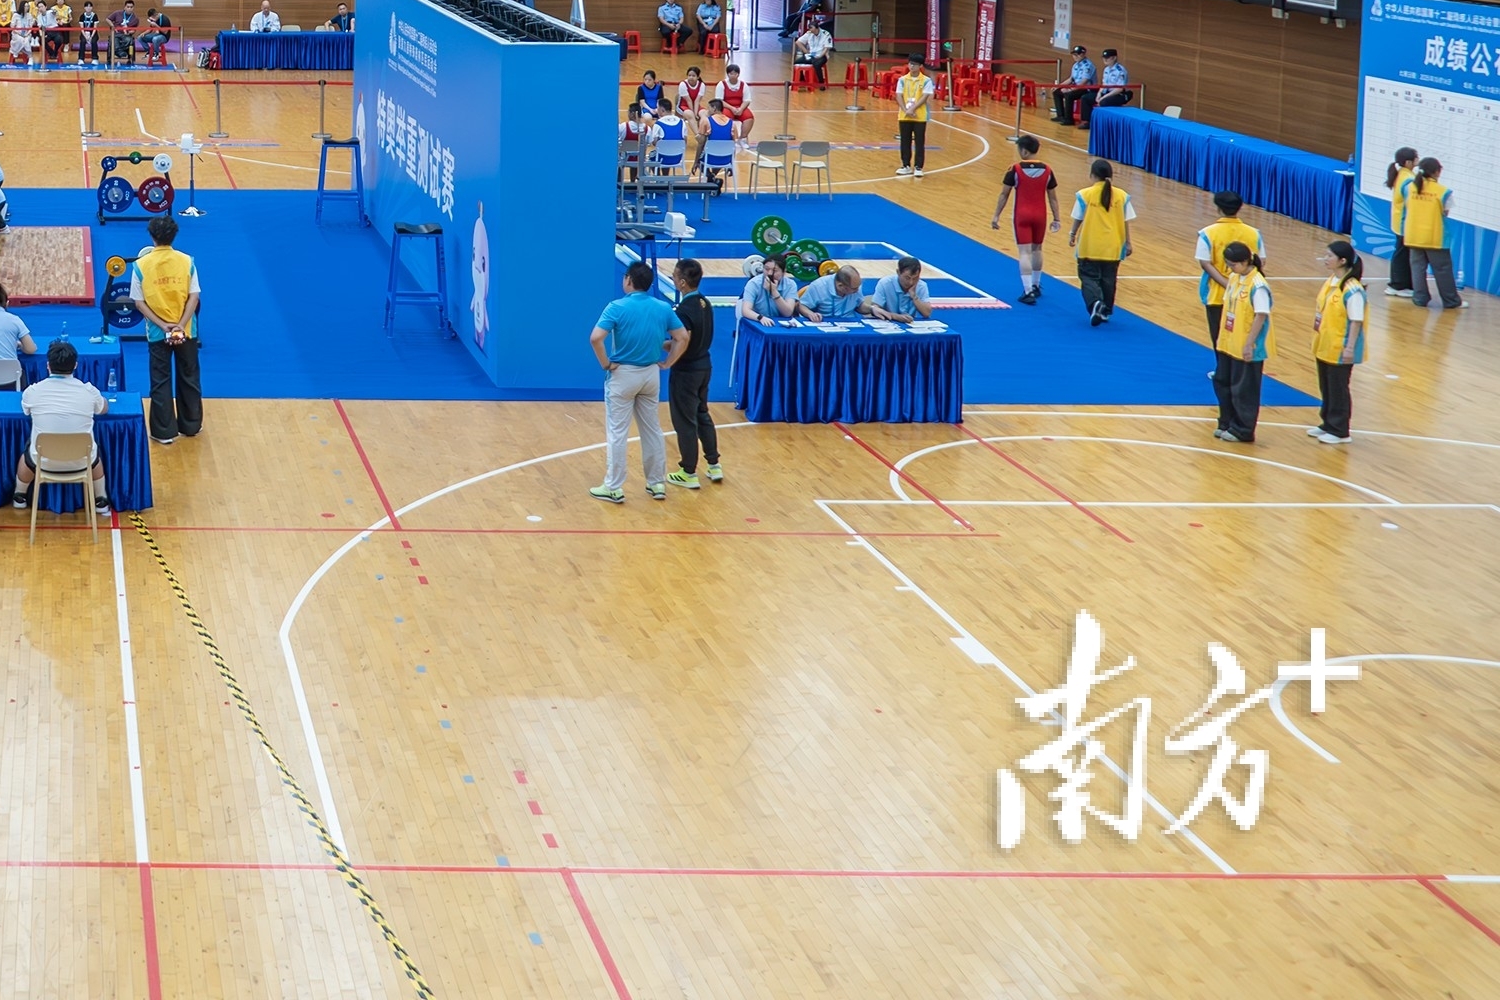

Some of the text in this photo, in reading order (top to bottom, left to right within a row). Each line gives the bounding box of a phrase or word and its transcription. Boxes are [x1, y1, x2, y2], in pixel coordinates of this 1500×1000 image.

[376, 88, 455, 222] 特奥举重测试赛
